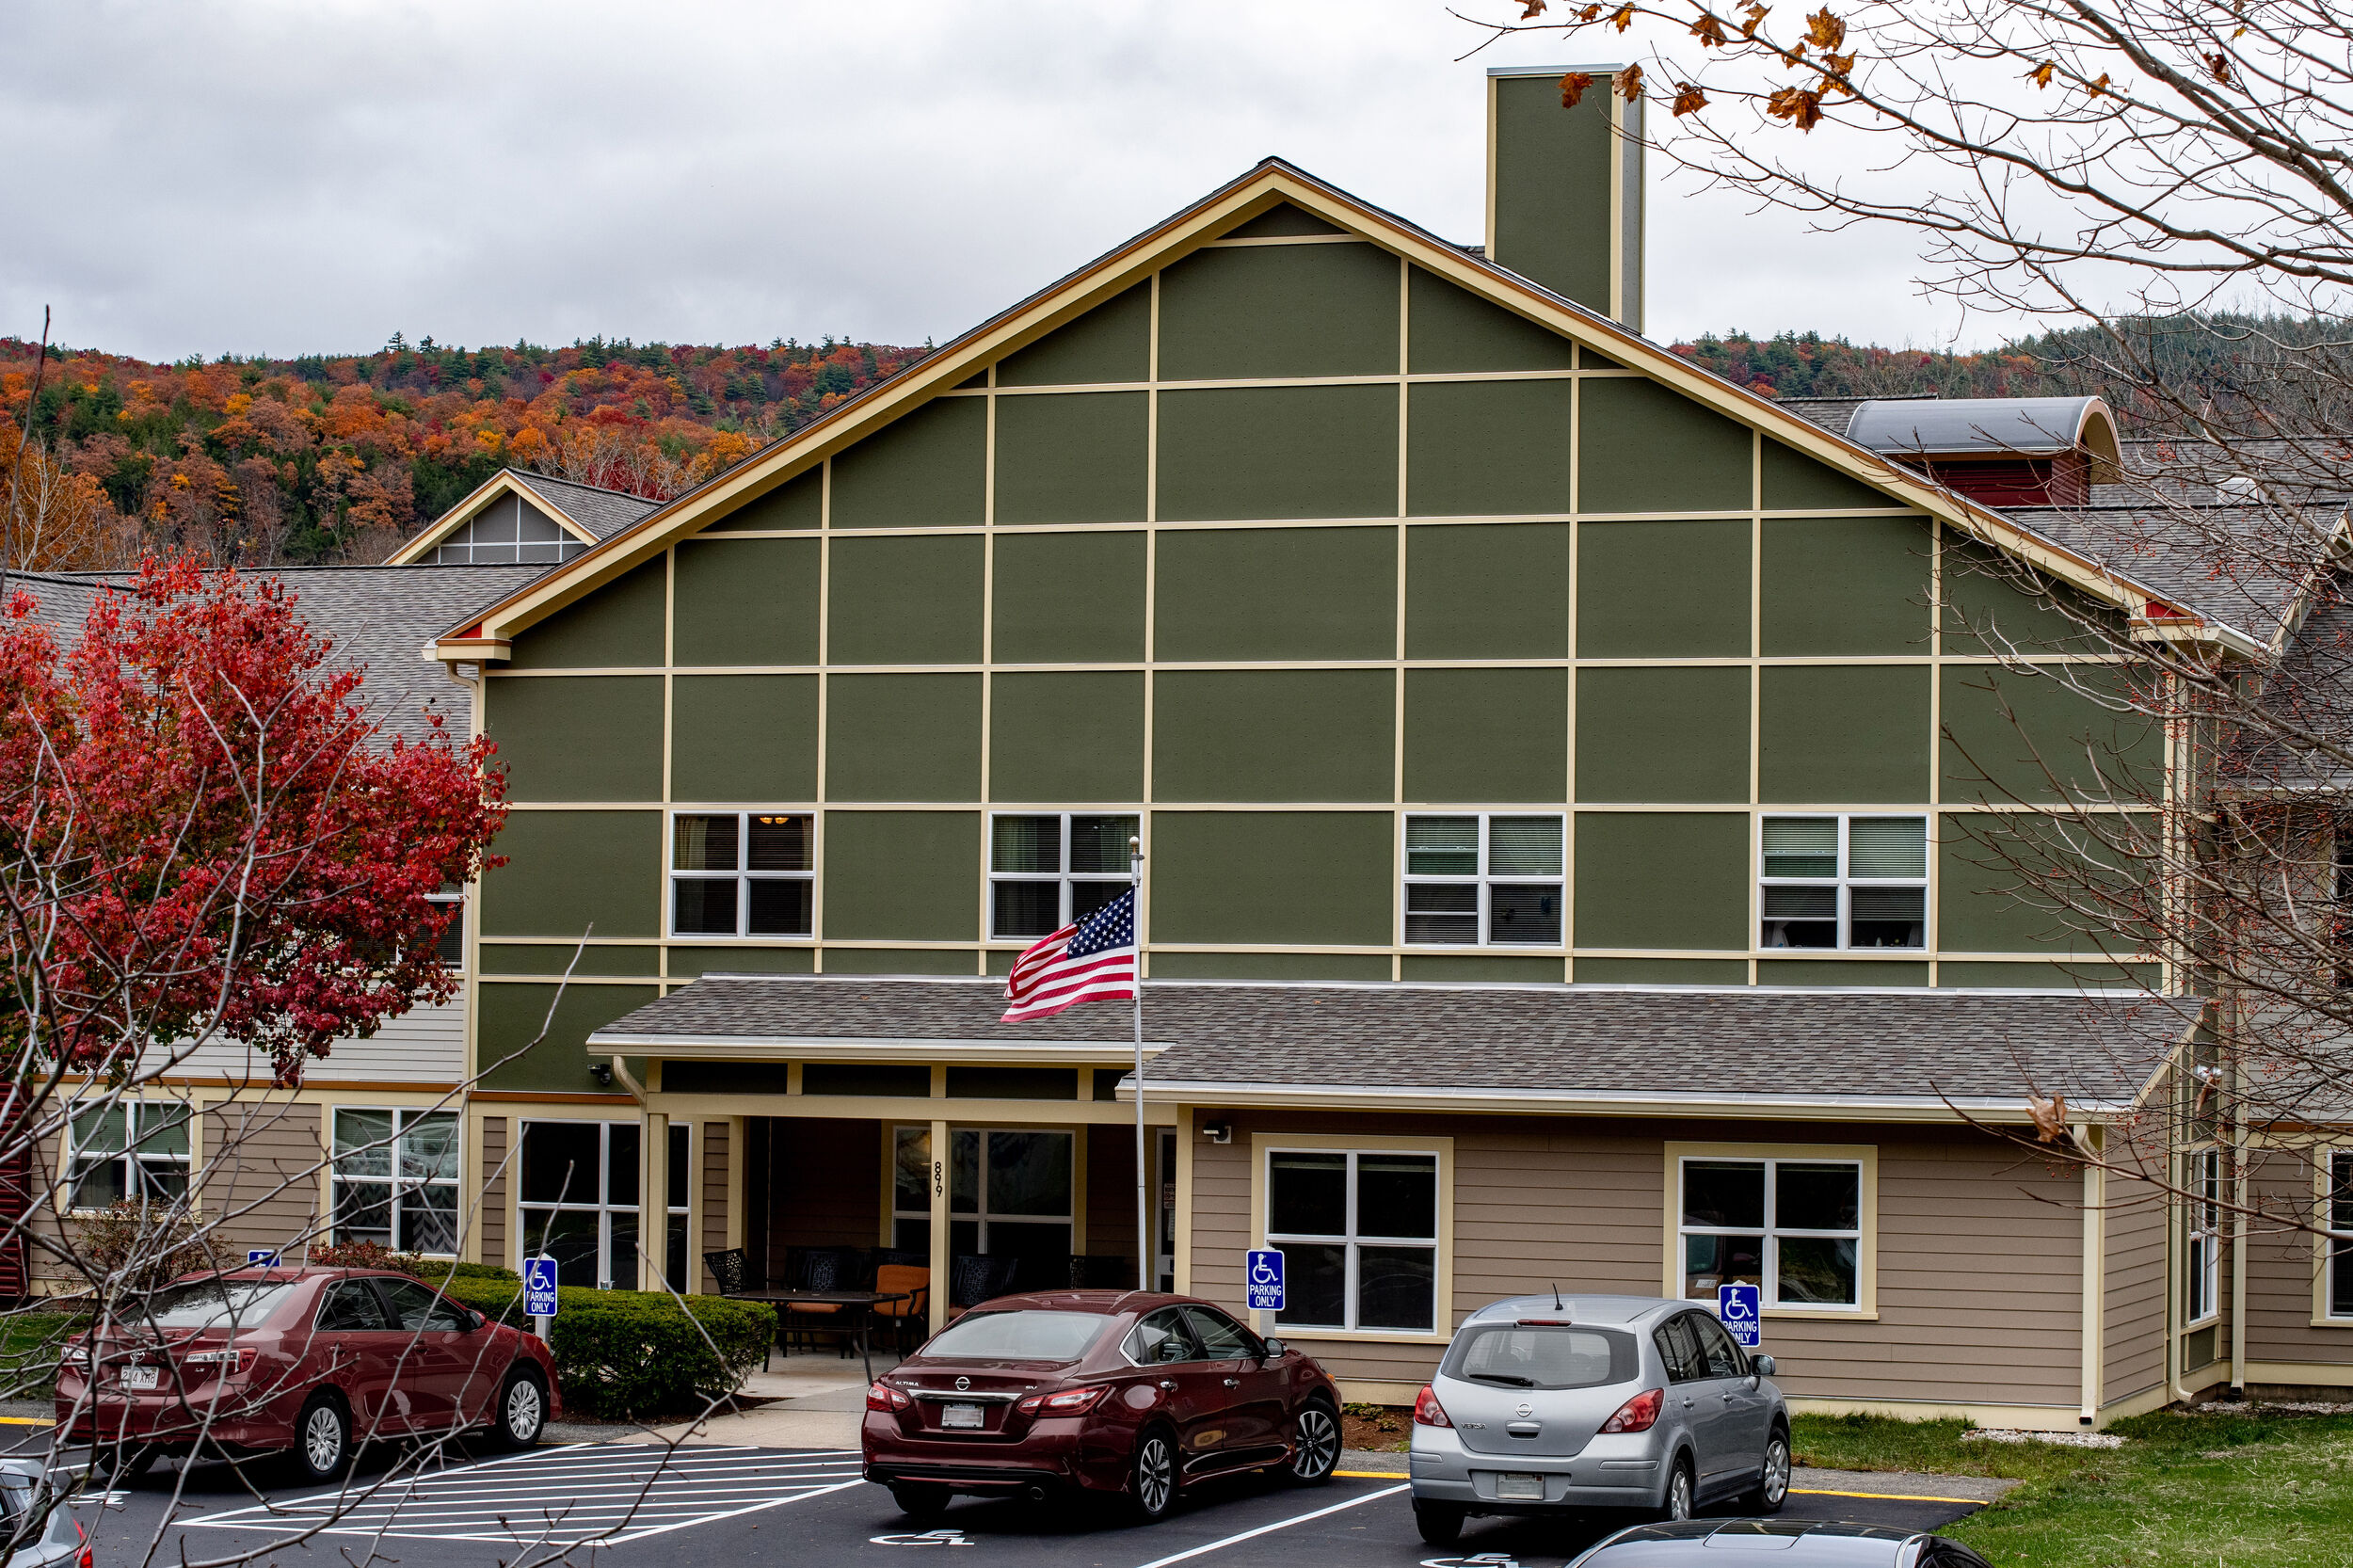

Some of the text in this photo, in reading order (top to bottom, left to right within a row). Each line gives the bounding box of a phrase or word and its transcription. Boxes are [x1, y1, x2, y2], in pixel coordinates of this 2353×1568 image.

[1250, 1285, 1282, 1296] PARKING
[1256, 1296, 1275, 1306] ONLY
[531, 1302, 550, 1312] ONLY
[1732, 1333, 1751, 1343] NLY
